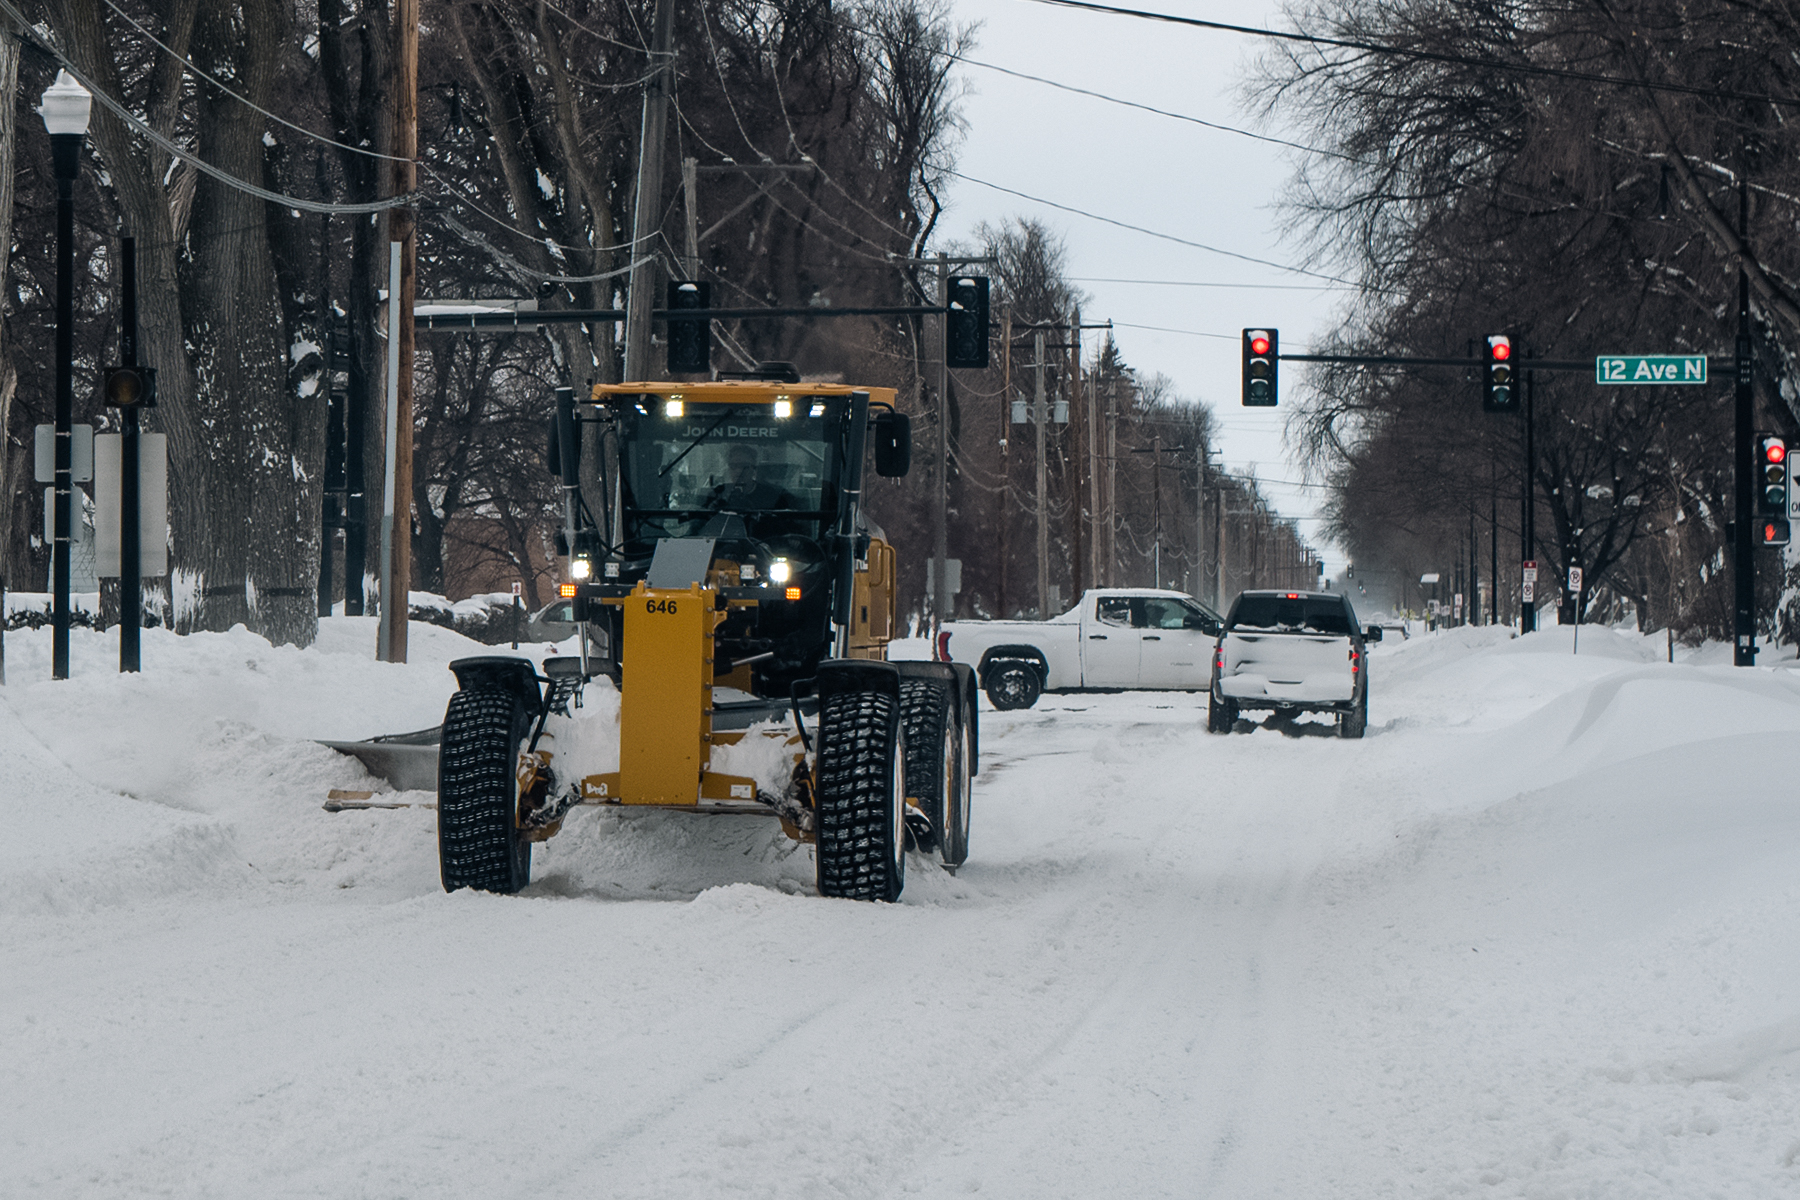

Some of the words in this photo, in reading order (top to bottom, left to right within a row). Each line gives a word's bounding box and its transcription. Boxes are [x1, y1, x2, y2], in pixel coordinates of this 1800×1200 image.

[1603, 360, 1626, 380] 12
[1633, 360, 1678, 380] Ave
[1684, 360, 1701, 380] N
[727, 426, 778, 438] DEERE
[646, 599, 677, 614] 646
